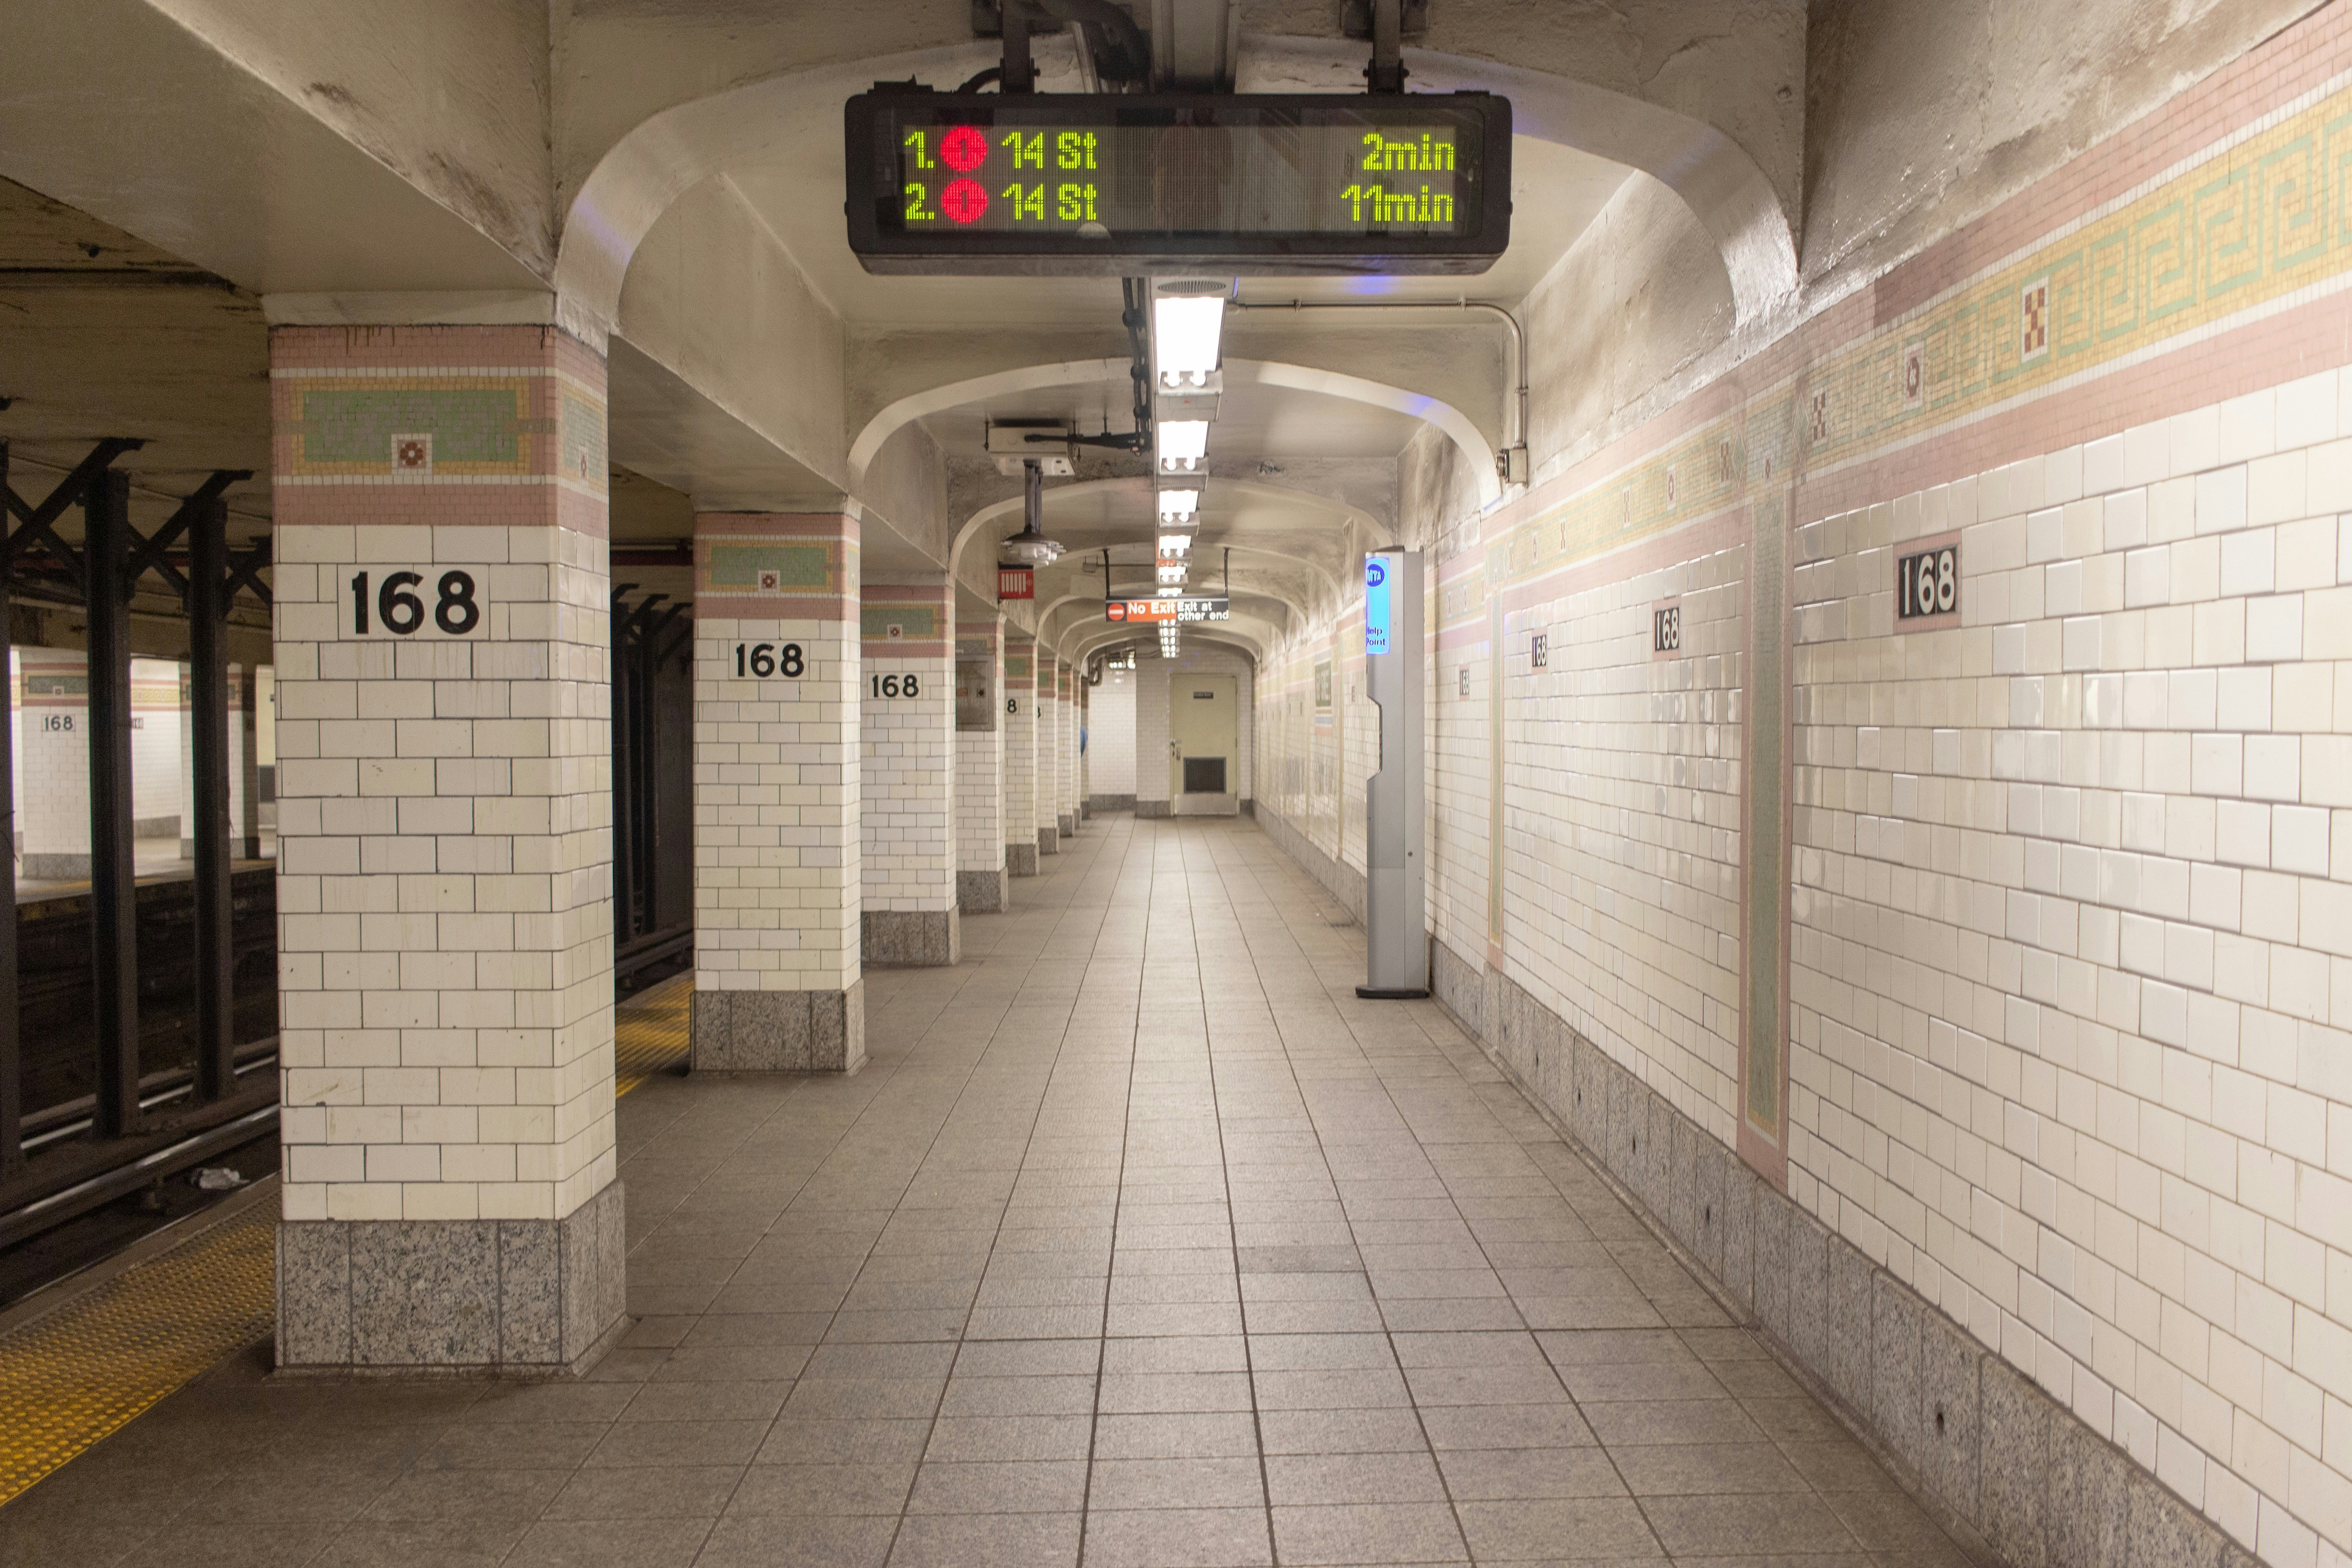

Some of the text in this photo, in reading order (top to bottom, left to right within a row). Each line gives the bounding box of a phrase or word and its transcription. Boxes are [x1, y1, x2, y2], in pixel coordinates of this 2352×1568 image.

[905, 132, 933, 168] 1.
[1002, 132, 1043, 169] 14
[1058, 132, 1096, 169] St
[1364, 134, 1454, 170] 2min
[905, 183, 934, 219] 2.
[1002, 184, 1043, 220] 14
[1058, 184, 1096, 220] St
[1341, 185, 1453, 221] 11min
[1904, 550, 1955, 615] 168
[352, 570, 480, 635] 168
[1128, 602, 1176, 615] No Exit
[1177, 601, 1212, 612] Exit at
[1177, 610, 1229, 621] other end
[1657, 609, 1679, 650] 168
[736, 643, 804, 677] 168
[1533, 635, 1547, 666] 168
[873, 674, 919, 697] 168
[1460, 670, 1469, 695] 168
[45, 715, 72, 731] 168
